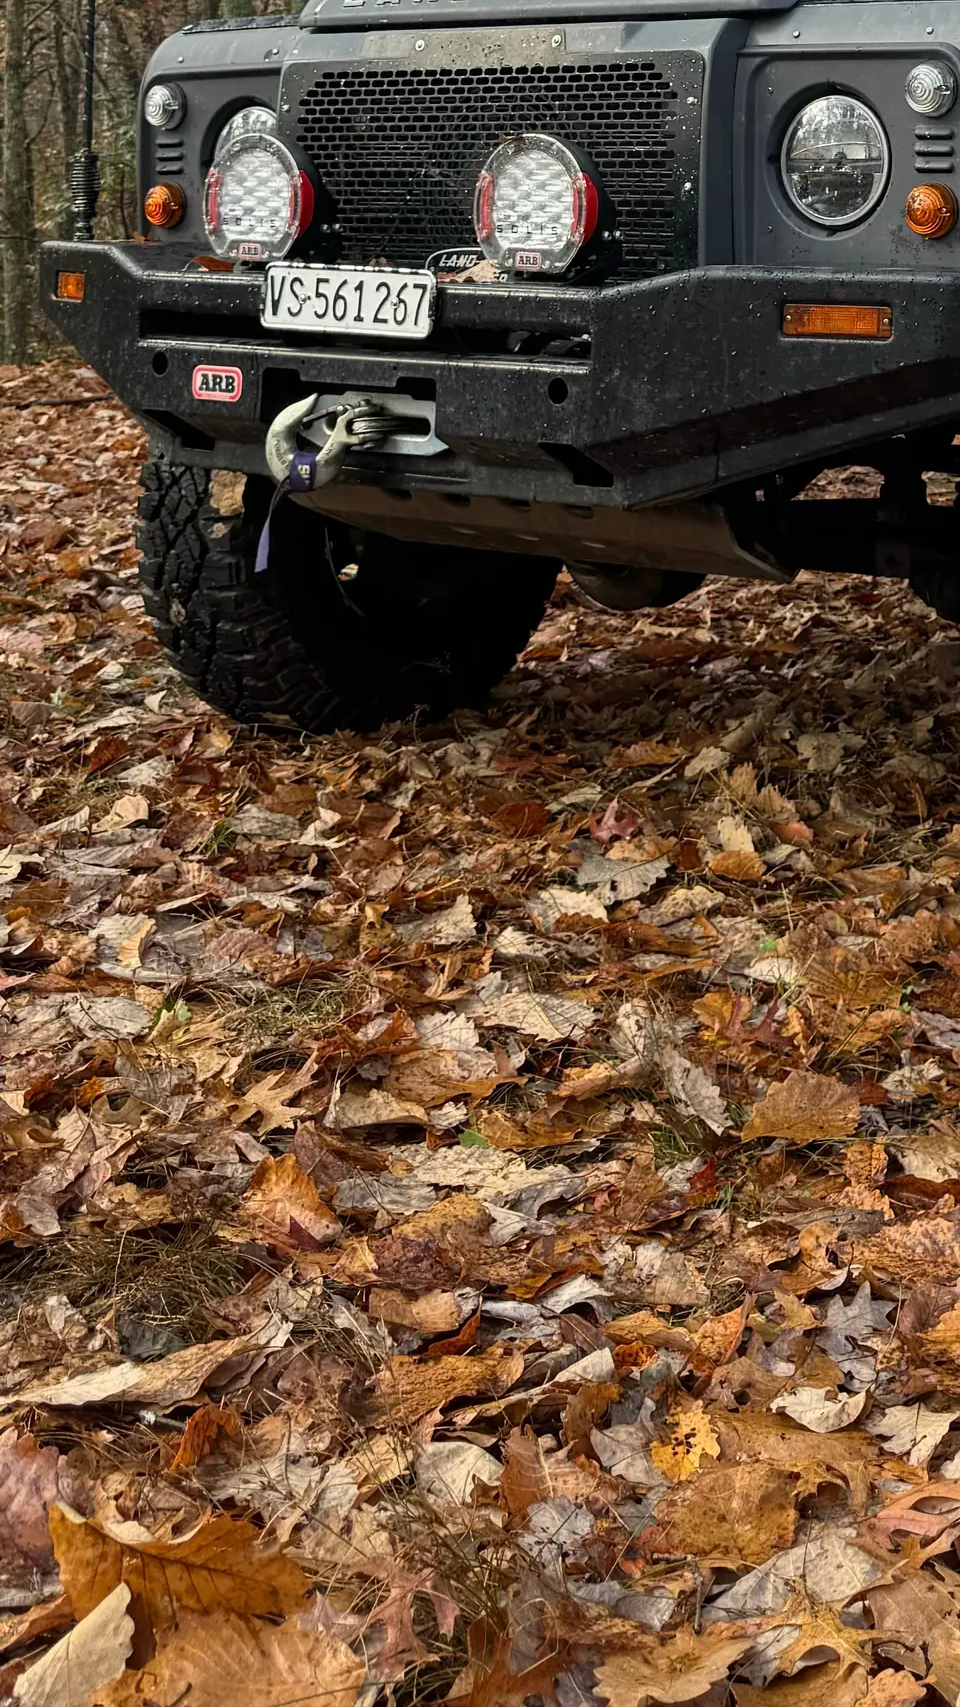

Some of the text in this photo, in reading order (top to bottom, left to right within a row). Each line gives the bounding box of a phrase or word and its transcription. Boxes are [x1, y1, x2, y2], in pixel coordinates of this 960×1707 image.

[496, 224, 558, 235] SOLIS
[518, 255, 539, 266] ARB
[198, 373, 236, 394] ARB
